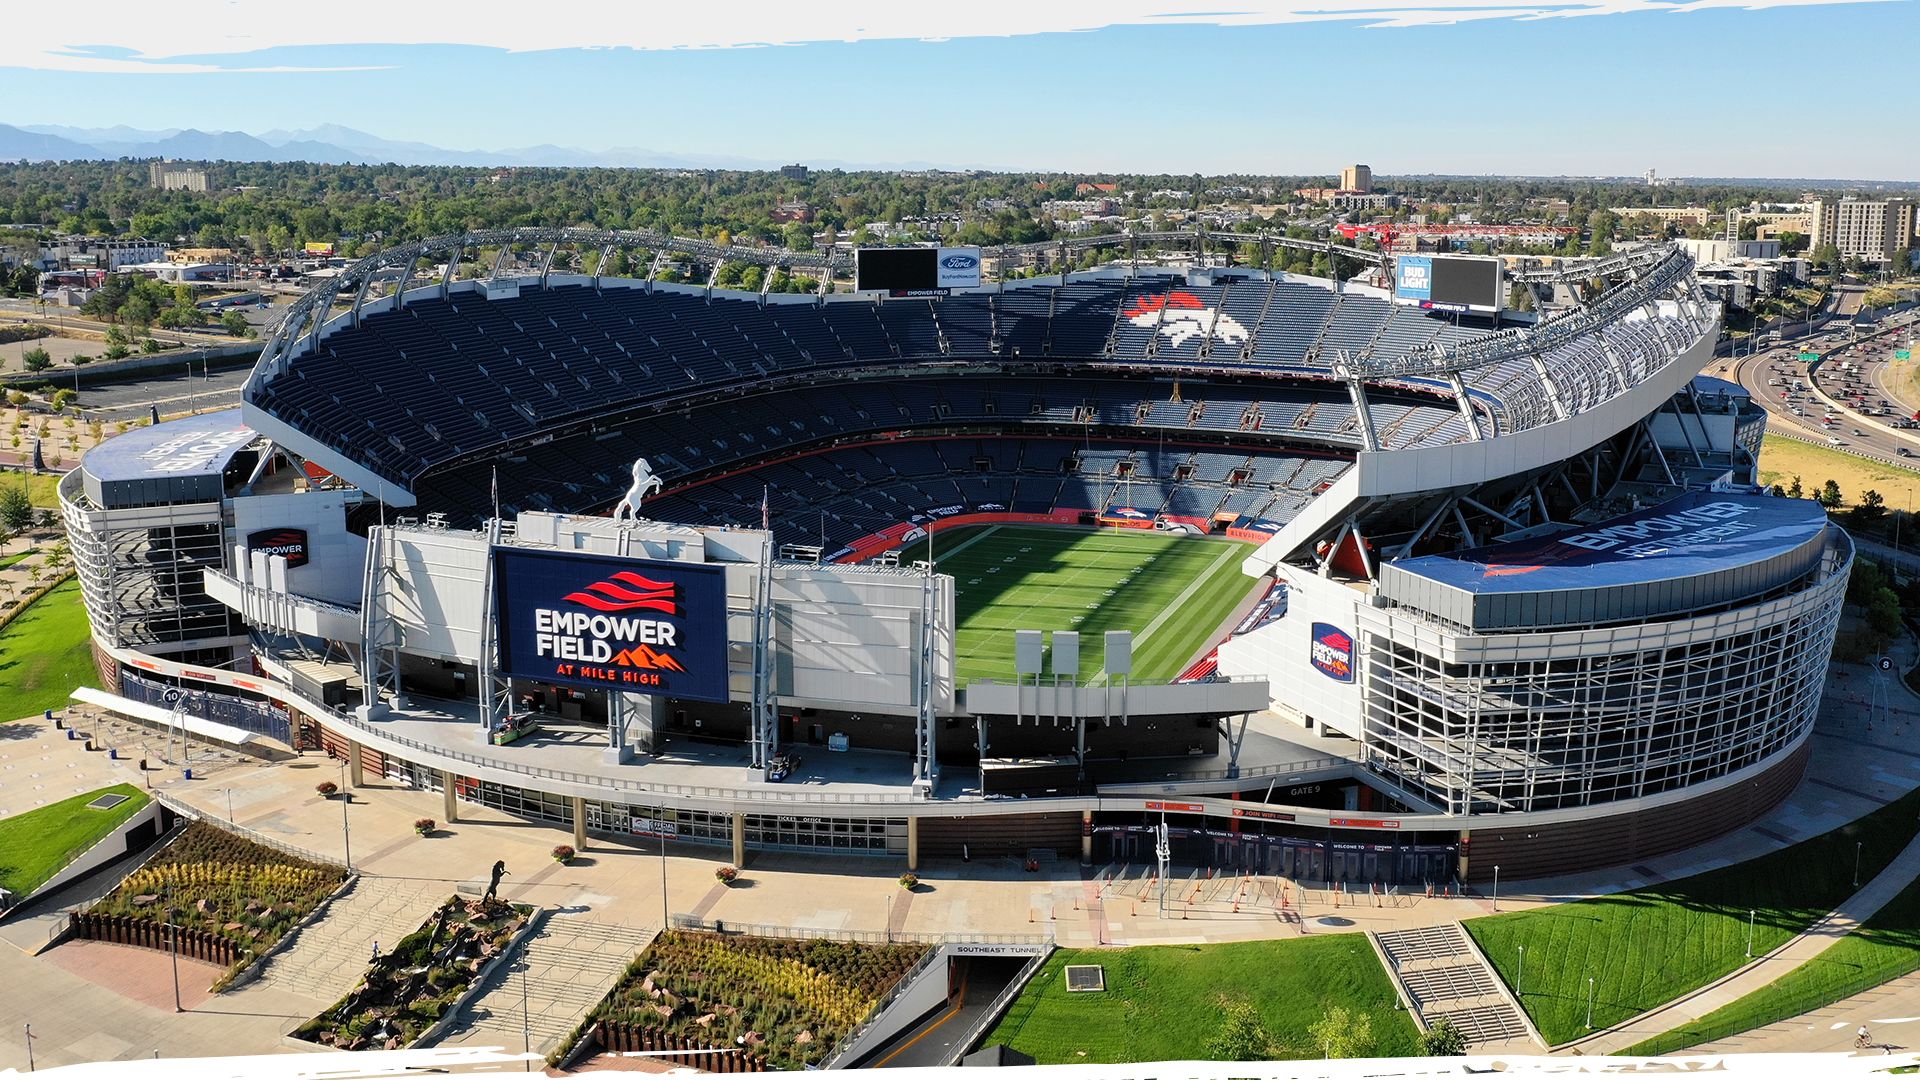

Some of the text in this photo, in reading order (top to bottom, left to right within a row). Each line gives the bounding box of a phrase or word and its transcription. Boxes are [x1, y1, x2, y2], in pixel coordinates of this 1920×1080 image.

[947, 257, 971, 268] Ford
[1404, 266, 1425, 277] BUD
[1401, 277, 1429, 289] LIGHT
[907, 289, 933, 297] EMPOWER
[1558, 501, 1759, 551] EMPOWER
[535, 608, 676, 647] EMPOWER
[536, 633, 612, 664] FIELD
[1312, 640, 1349, 665] EMPOWER
[1312, 650, 1333, 666] FIELD
[1882, 661, 1890, 669] 8
[556, 664, 660, 686] AT MILE HIGH
[166, 692, 178, 701] 10
[1290, 785, 1321, 796] GATE 9
